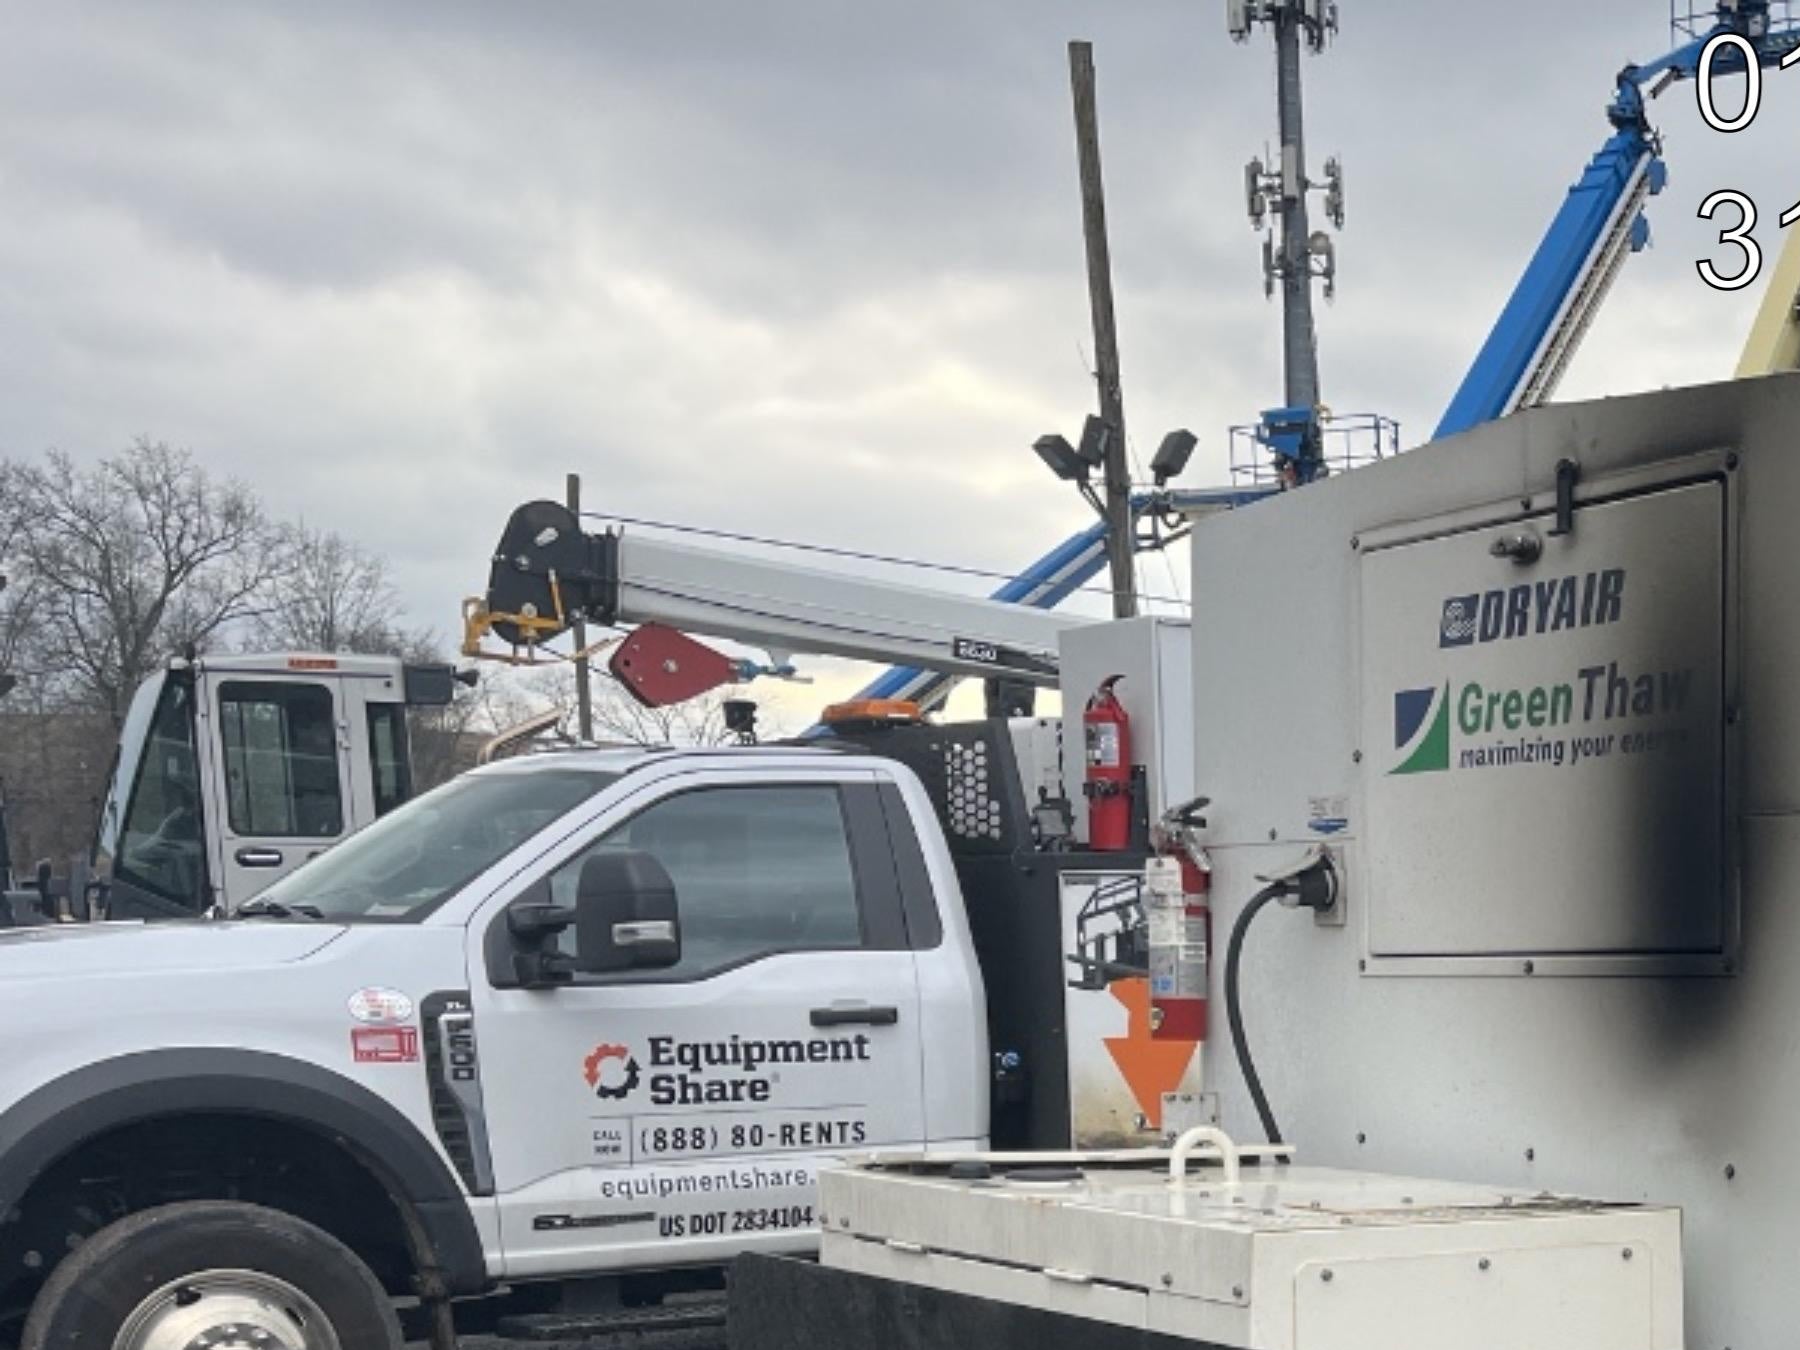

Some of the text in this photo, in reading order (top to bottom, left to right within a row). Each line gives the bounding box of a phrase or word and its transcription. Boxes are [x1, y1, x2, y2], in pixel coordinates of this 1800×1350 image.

[1478, 568, 1626, 643] DRYAIR
[1459, 734, 1565, 769] maximizing
[1571, 731, 1615, 765] your
[647, 1033, 872, 1072] Equipment
[648, 1073, 772, 1106] Share
[641, 1120, 867, 1154] (888) 80-RENTS
[658, 1214, 685, 1237] US
[690, 1211, 726, 1235] DOT
[731, 1205, 815, 1233] 2834104
